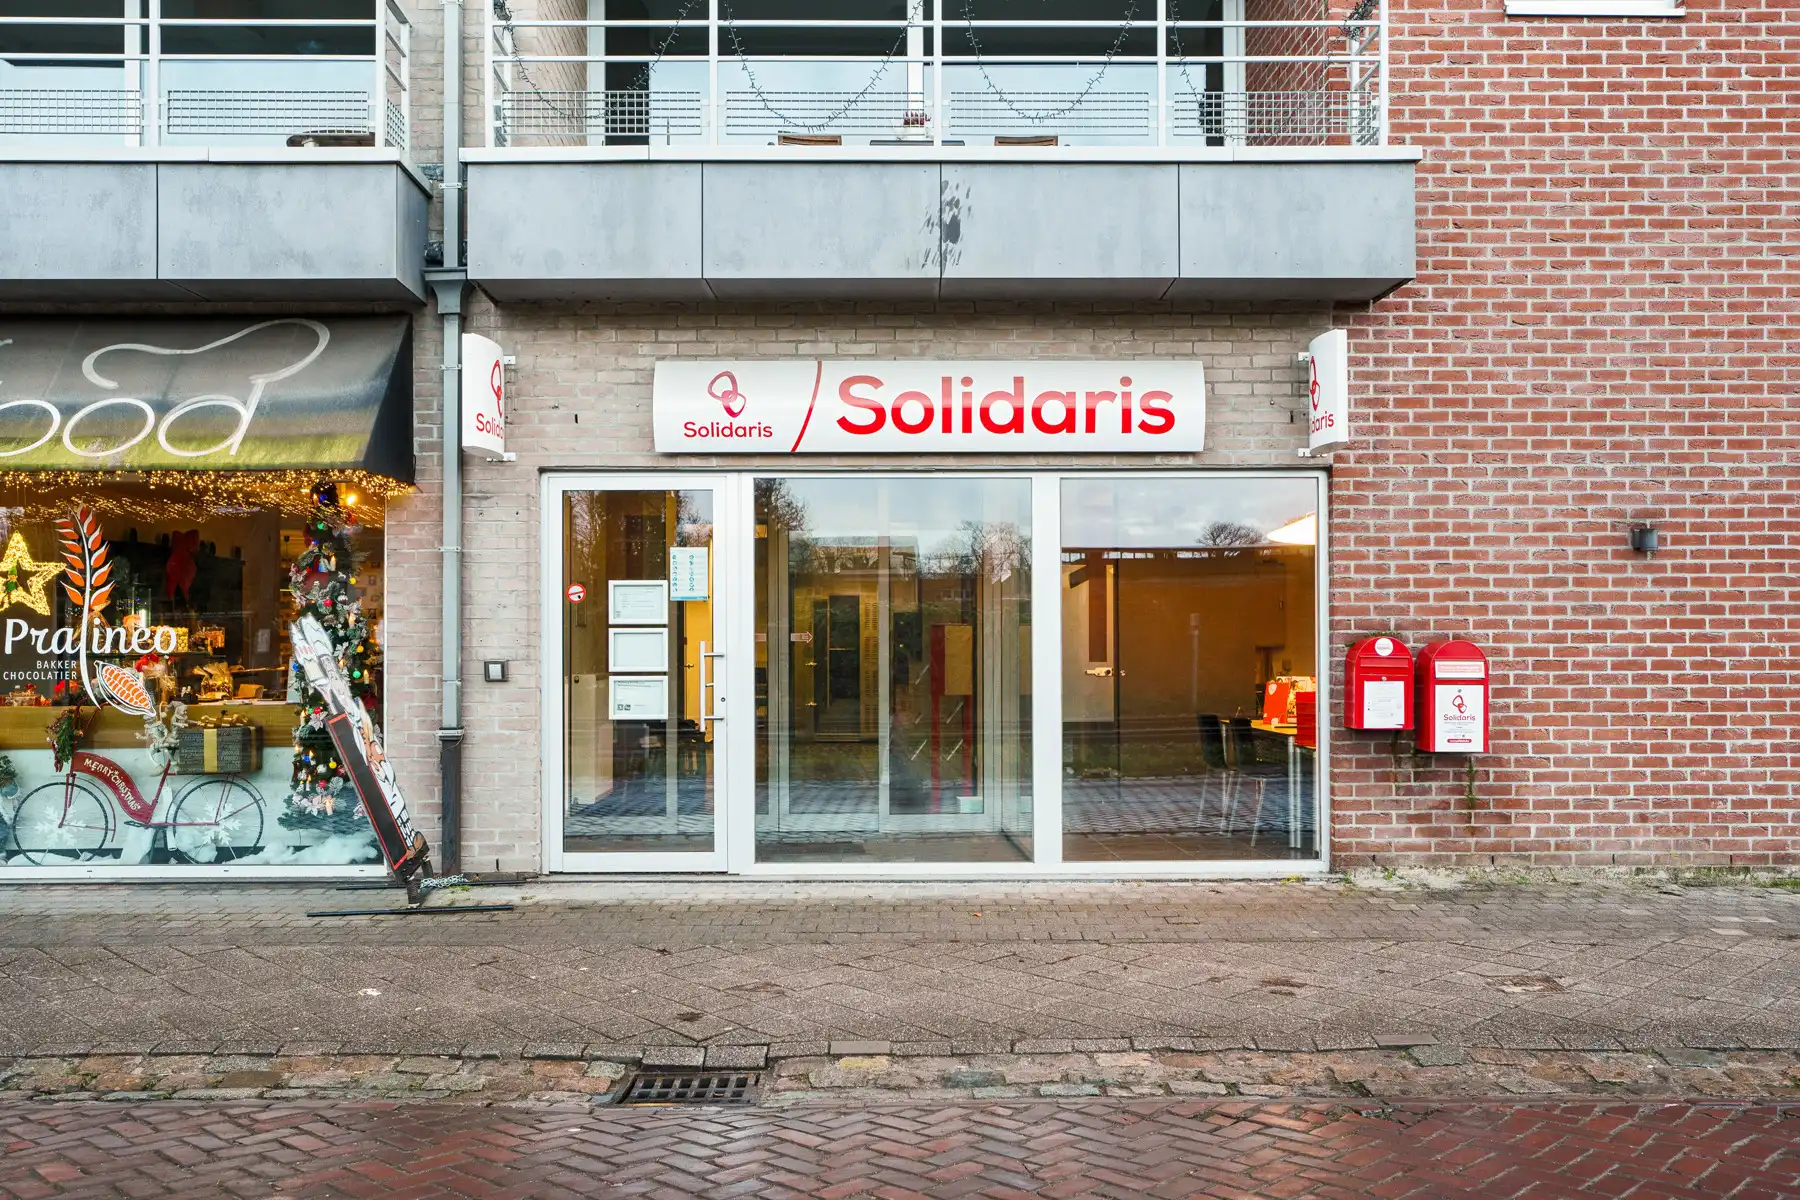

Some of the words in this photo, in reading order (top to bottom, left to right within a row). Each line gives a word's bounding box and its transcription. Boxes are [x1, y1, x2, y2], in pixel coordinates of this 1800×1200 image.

[836, 376, 1175, 435] Solidaris
[684, 421, 773, 438] Solidaris
[4, 617, 177, 655] Pralineo
[36, 660, 77, 669] BAKKER
[3, 671, 77, 681] CHOCOLATIER
[1443, 713, 1476, 721] Solidaris
[84, 758, 113, 776] MERRY
[111, 773, 139, 811] CHRISTMAS
